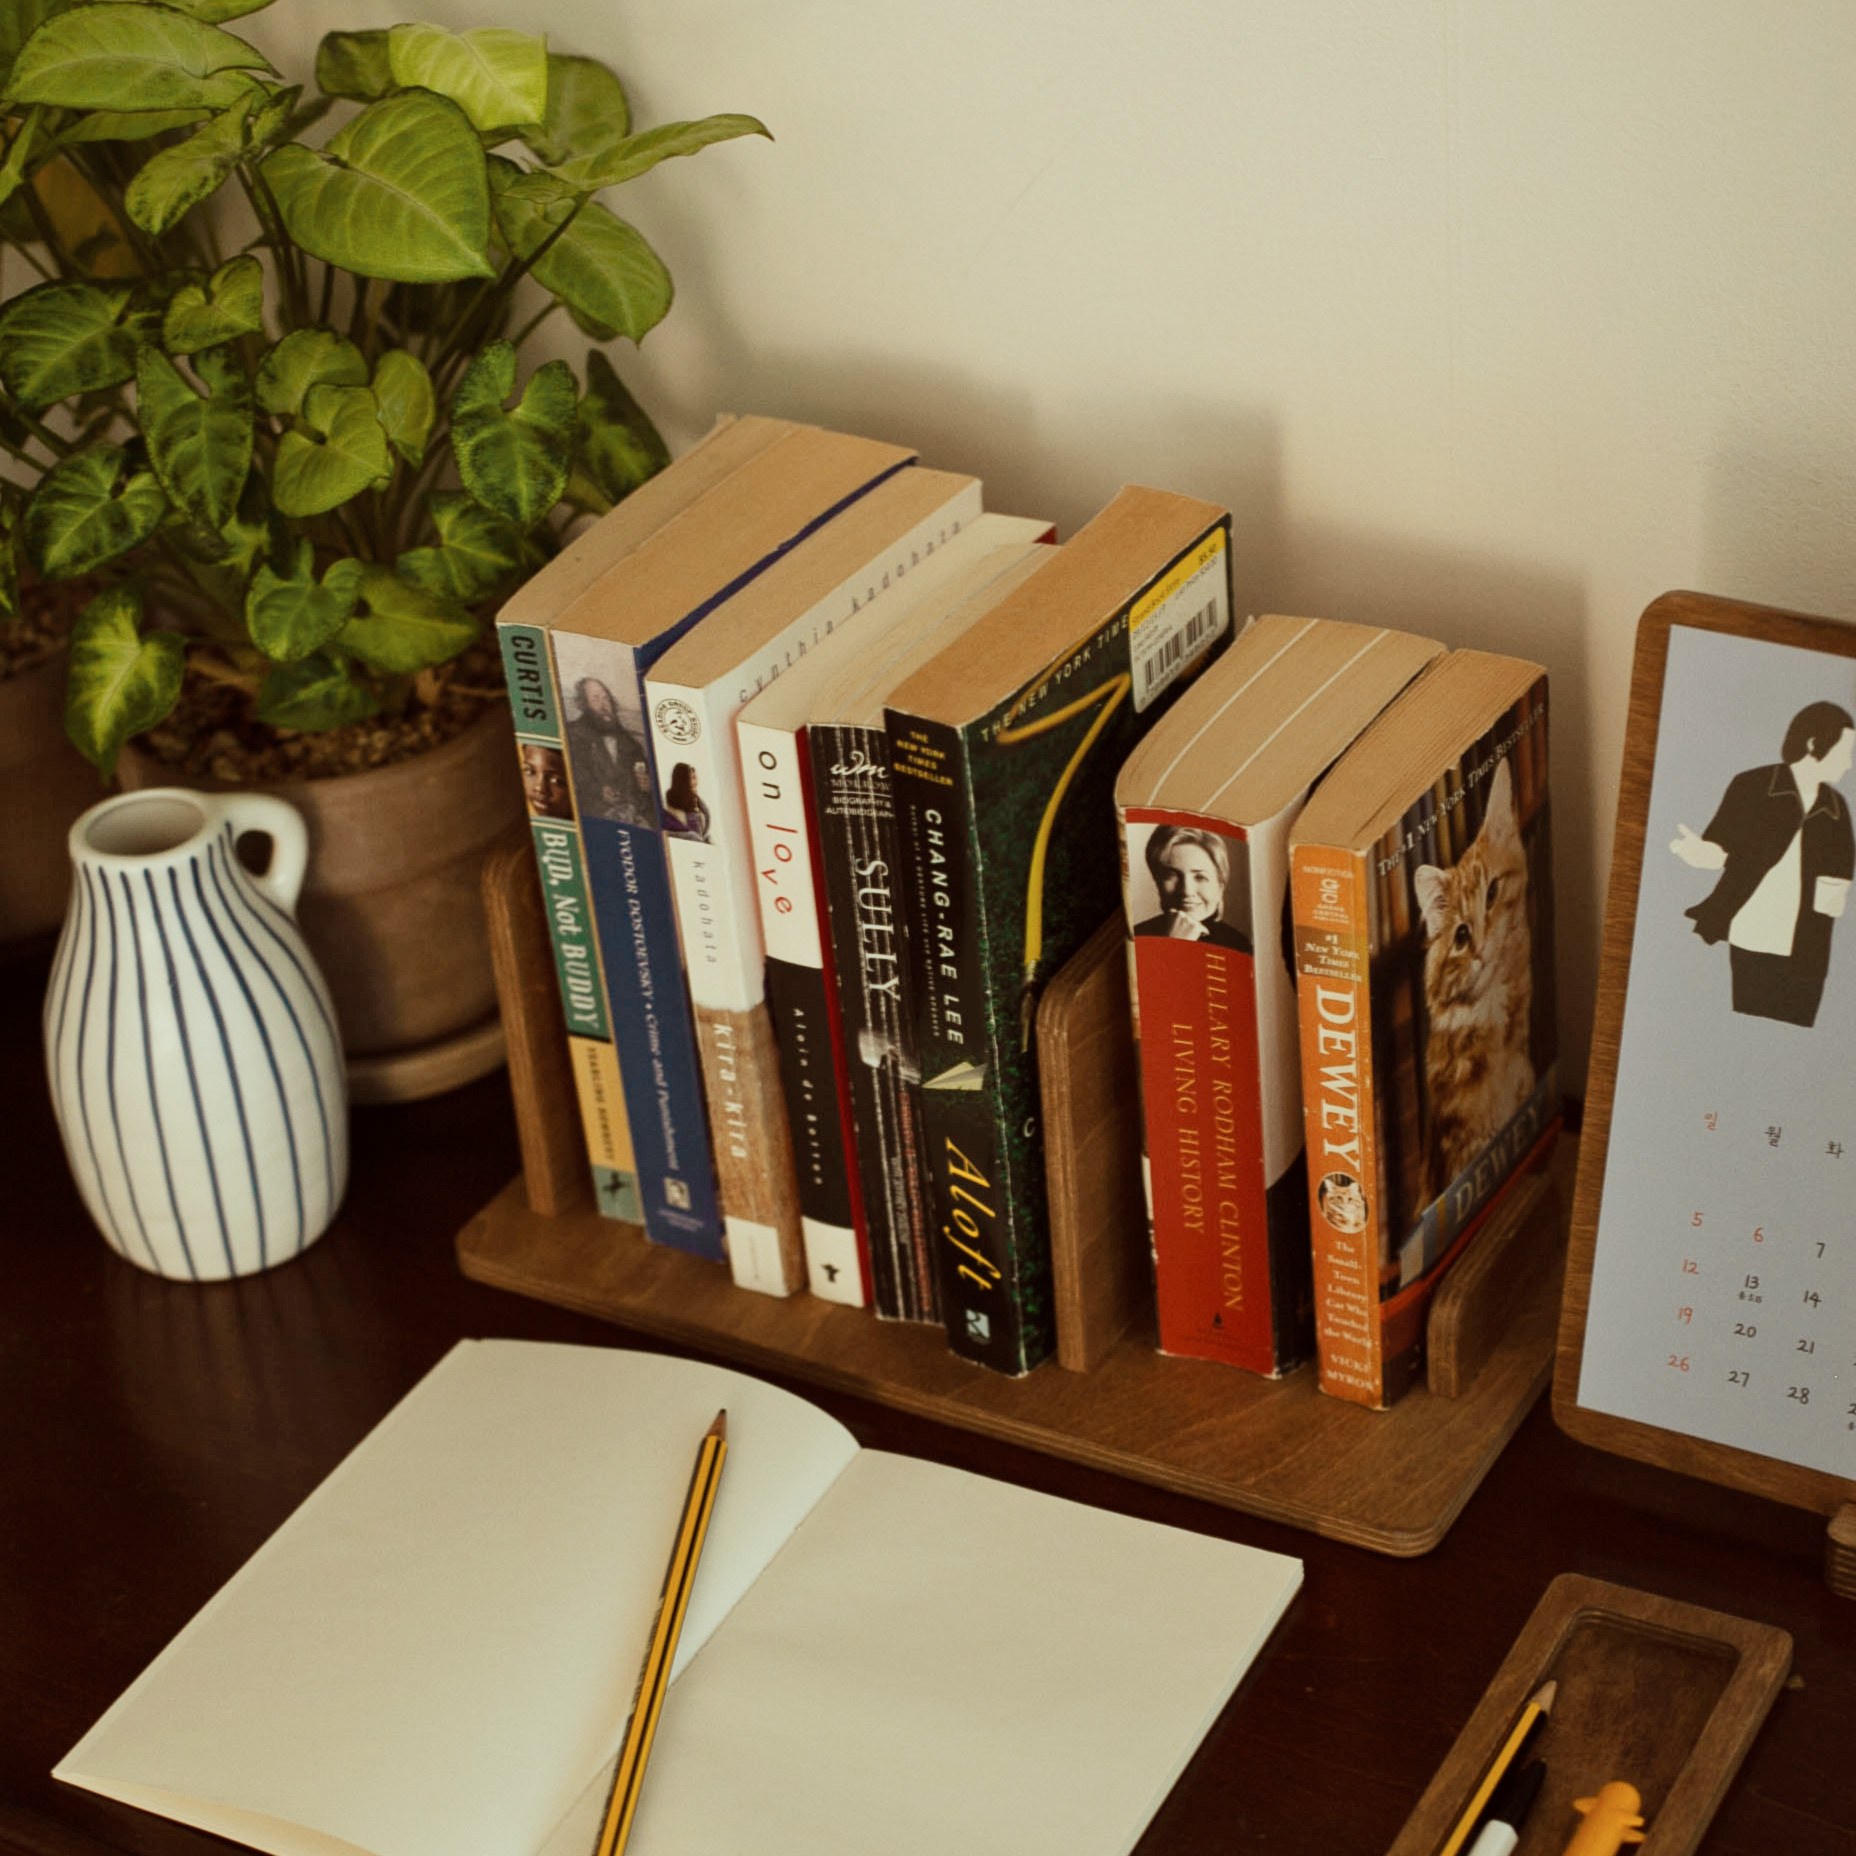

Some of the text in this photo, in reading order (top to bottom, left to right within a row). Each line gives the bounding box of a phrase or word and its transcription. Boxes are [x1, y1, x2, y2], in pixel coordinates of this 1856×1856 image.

[511, 635, 547, 722] CURTIS
[980, 713, 1012, 743] THE
[1018, 683, 1050, 716] NEW
[1054, 650, 1091, 684] YORK
[1097, 614, 1130, 649] TIME
[893, 762, 953, 786] BESTSELLER
[908, 754, 938, 770] TIMES
[920, 747, 946, 760] YORK
[758, 750, 799, 915] on love
[553, 894, 583, 936] Not
[617, 829, 654, 1000] FYODOR DOSTOEVSKY
[691, 860, 717, 964] kadohata
[855, 857, 901, 1001] SULLY
[925, 808, 964, 1044] CHANG-RAE LEE
[563, 943, 599, 1030] BUDDY
[1316, 984, 1362, 1173] DEWEY
[1171, 1023, 1205, 1235] LIVING HISTORY
[1205, 952, 1245, 1311] HILLARY RODHAM CLINTON
[1455, 1105, 1539, 1223] DEWEY
[943, 1136, 1002, 1290] Aloft
[1691, 1211, 1826, 1259] 5 6 7
[1335, 1240, 1355, 1253] The
[1325, 1298, 1368, 1317] Cat Who
[1327, 1284, 1368, 1302] Library
[1682, 1259, 1822, 1308] 12 13 14
[1324, 1327, 1372, 1348] the World
[1677, 1306, 1815, 1354] 19 20 21
[1325, 1369, 1375, 1391] MYRON
[1330, 1353, 1370, 1373] VICKI
[1667, 1354, 1690, 1372] 26
[1728, 1371, 1750, 1387] 27
[1787, 1386, 1810, 1404] 28
